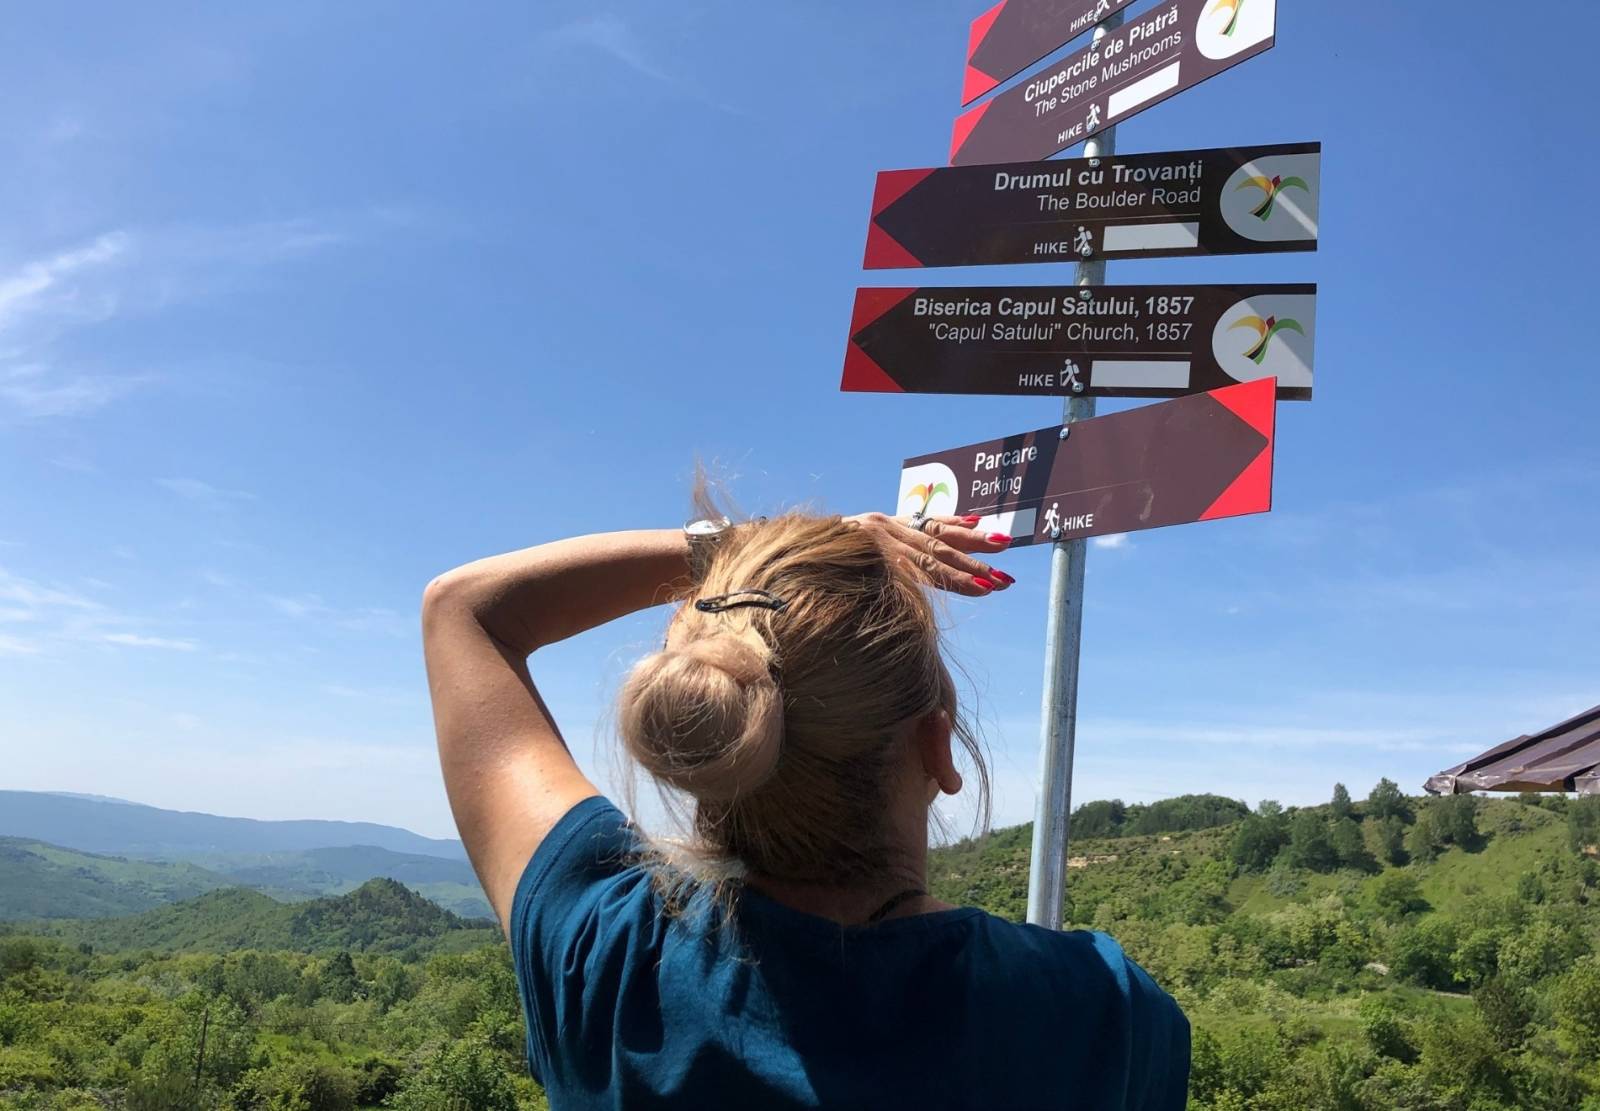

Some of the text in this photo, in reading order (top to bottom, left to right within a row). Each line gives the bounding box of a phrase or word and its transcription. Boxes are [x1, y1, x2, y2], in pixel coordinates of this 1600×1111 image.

[1070, 10, 1094, 32] HIKE
[1025, 6, 1179, 102] Ciupercile de Piatră
[1035, 31, 1182, 117] The Stone Mushrooms
[1058, 123, 1083, 143] HIKE
[995, 160, 1203, 190] Drumul cu Trovanți
[1037, 188, 1201, 211] The Boulder Road
[1033, 242, 1068, 255] HIKE
[914, 296, 1194, 320] Biserica Capul Satului, 1857
[928, 322, 1193, 344] "Capul Satului" Church, 1857
[1018, 374, 1054, 388] HIKE
[974, 445, 1038, 472] Parcare
[971, 475, 1022, 498] Parking
[1064, 514, 1094, 530] HIKE
